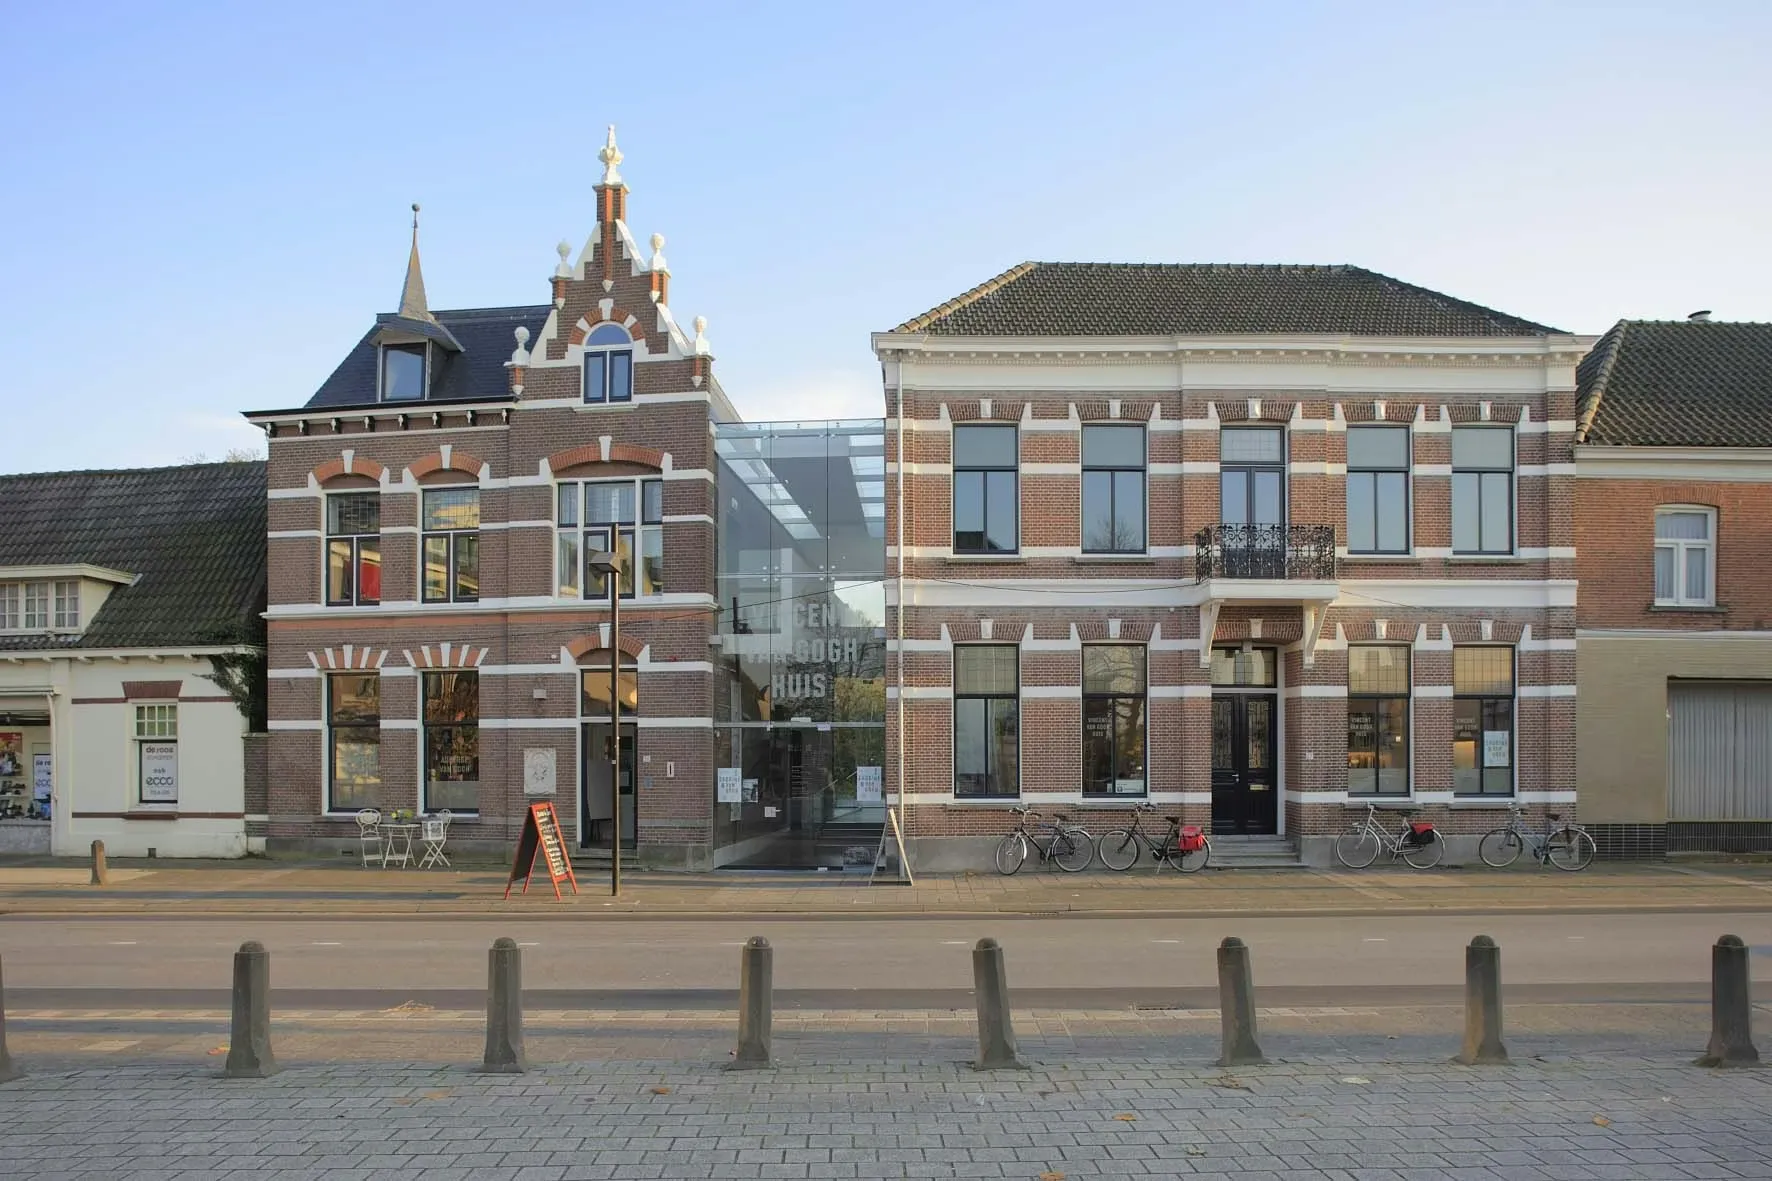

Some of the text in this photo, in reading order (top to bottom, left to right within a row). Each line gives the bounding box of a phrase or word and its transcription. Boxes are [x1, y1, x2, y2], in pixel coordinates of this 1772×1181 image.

[795, 638, 858, 663] GOGH
[772, 673, 826, 698] HUIS
[146, 776, 173, 786] ecco
